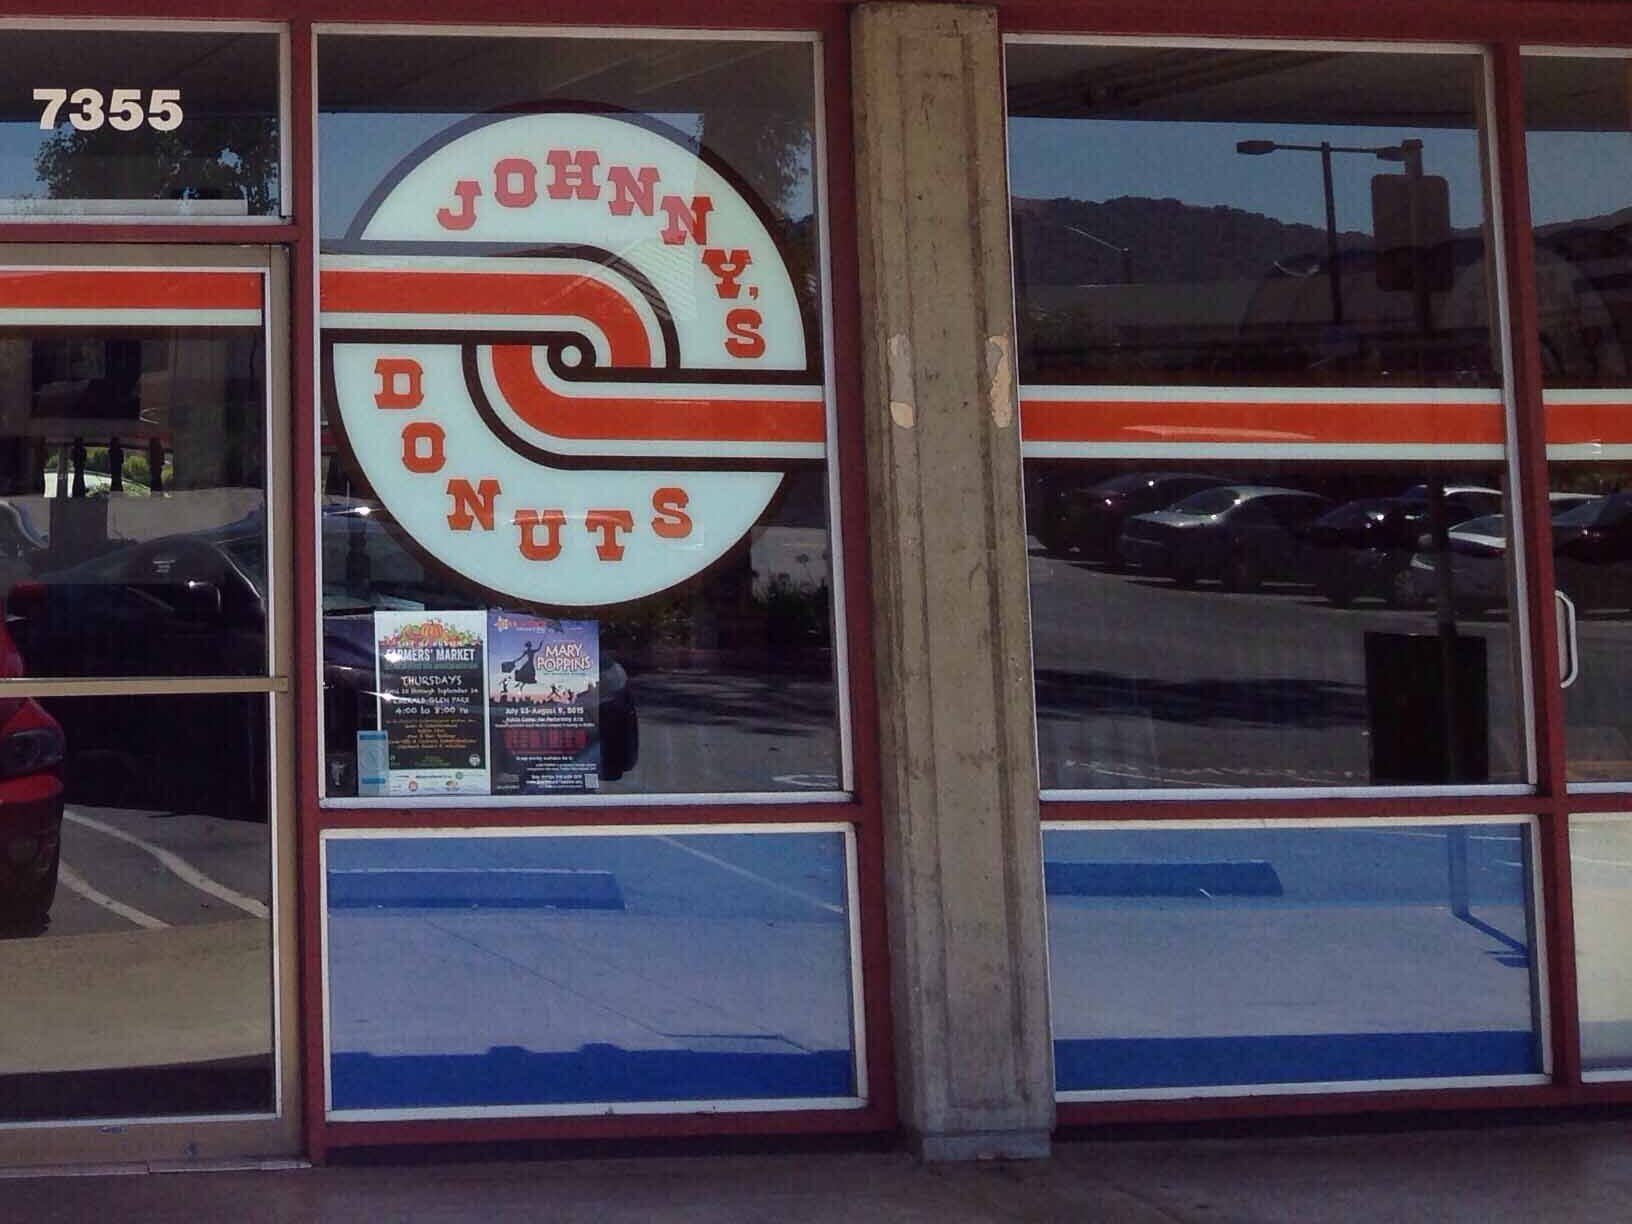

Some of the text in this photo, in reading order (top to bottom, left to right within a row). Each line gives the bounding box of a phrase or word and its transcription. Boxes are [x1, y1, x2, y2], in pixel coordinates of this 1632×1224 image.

[32, 87, 184, 131] 7355
[436, 150, 766, 359] JOHNNY'S
[374, 357, 694, 562] DONUTS
[435, 648, 476, 661] MARKET
[545, 643, 583, 658] MARY
[536, 656, 593, 672] POPPINS
[400, 675, 463, 686] THURSDAYS
